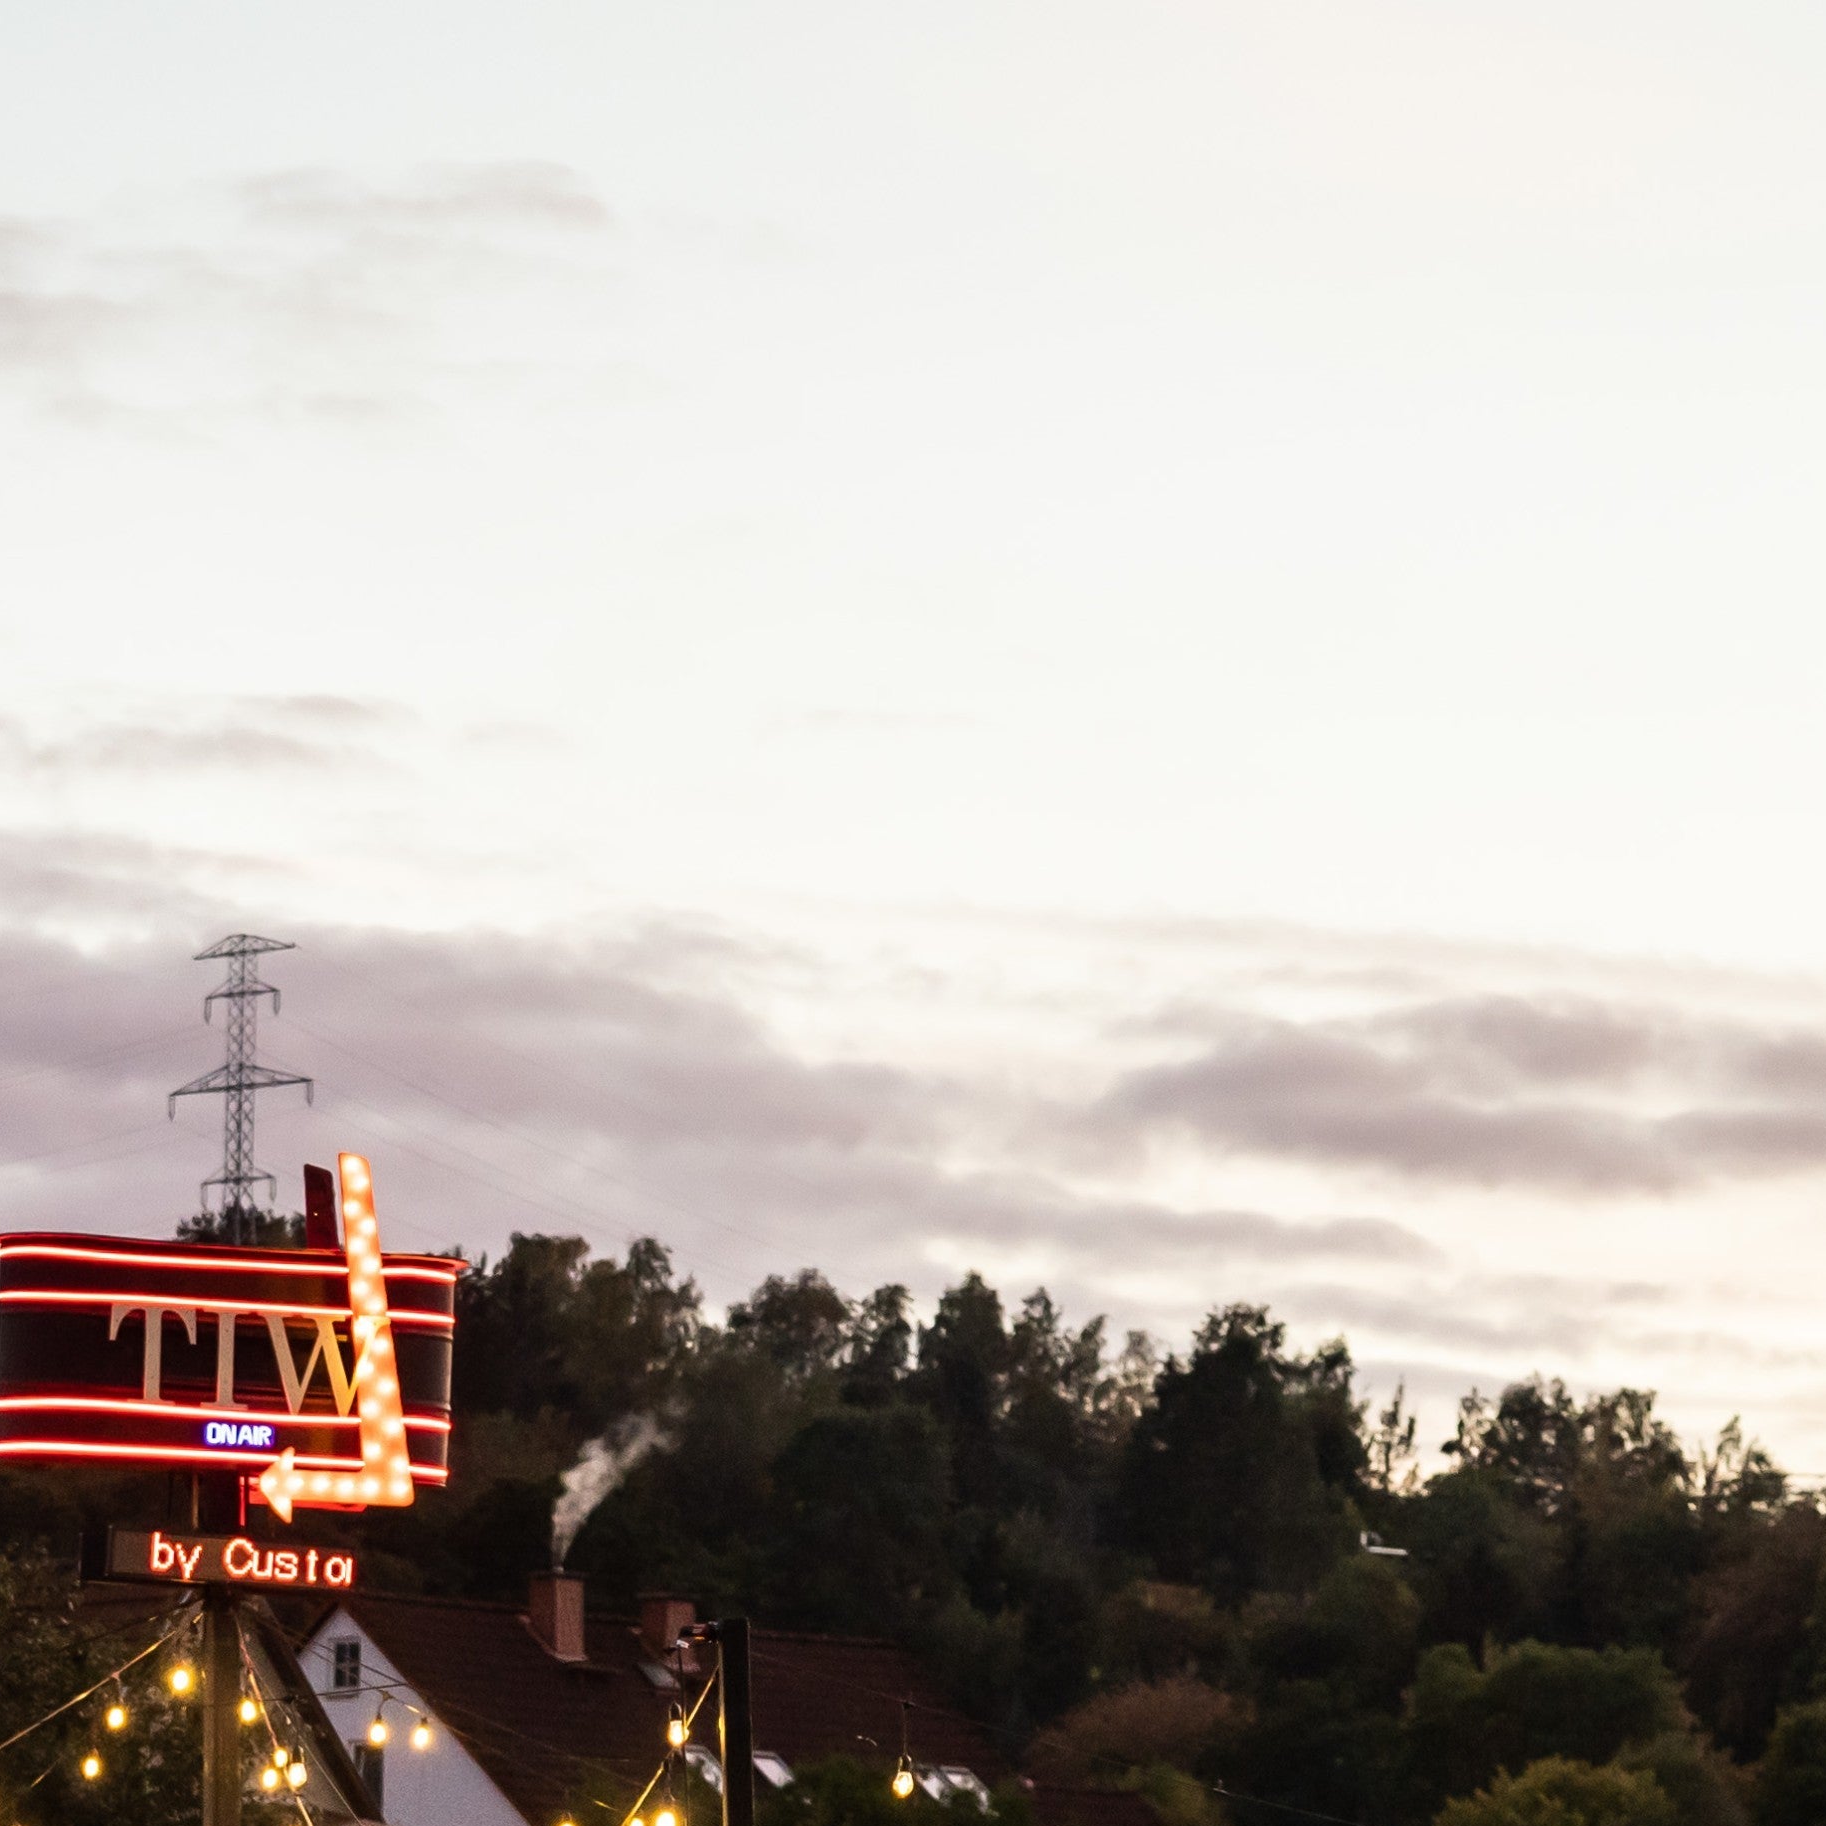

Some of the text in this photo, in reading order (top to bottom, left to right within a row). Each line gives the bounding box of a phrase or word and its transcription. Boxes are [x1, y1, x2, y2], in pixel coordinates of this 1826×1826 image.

[108, 1302, 391, 1418] TIW
[205, 1421, 274, 1447] ON AIR
[150, 1530, 203, 1582] by
